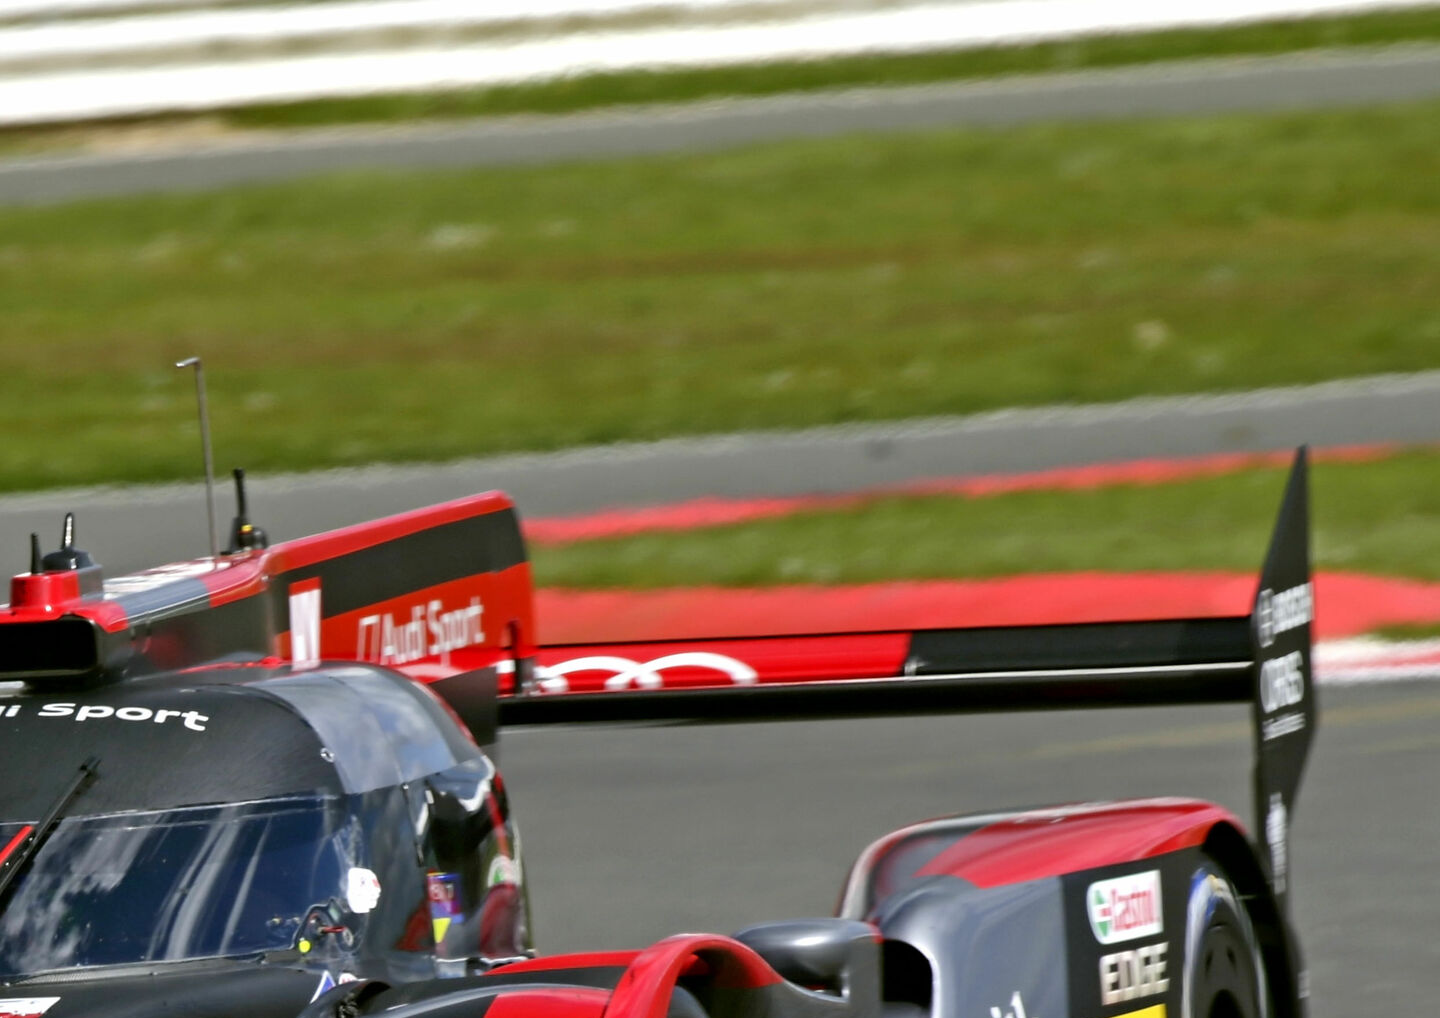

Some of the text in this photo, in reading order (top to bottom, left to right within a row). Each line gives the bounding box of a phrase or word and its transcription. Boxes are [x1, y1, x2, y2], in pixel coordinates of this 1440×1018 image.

[382, 598, 484, 668] Audi Sport
[37, 702, 210, 732] Sport
